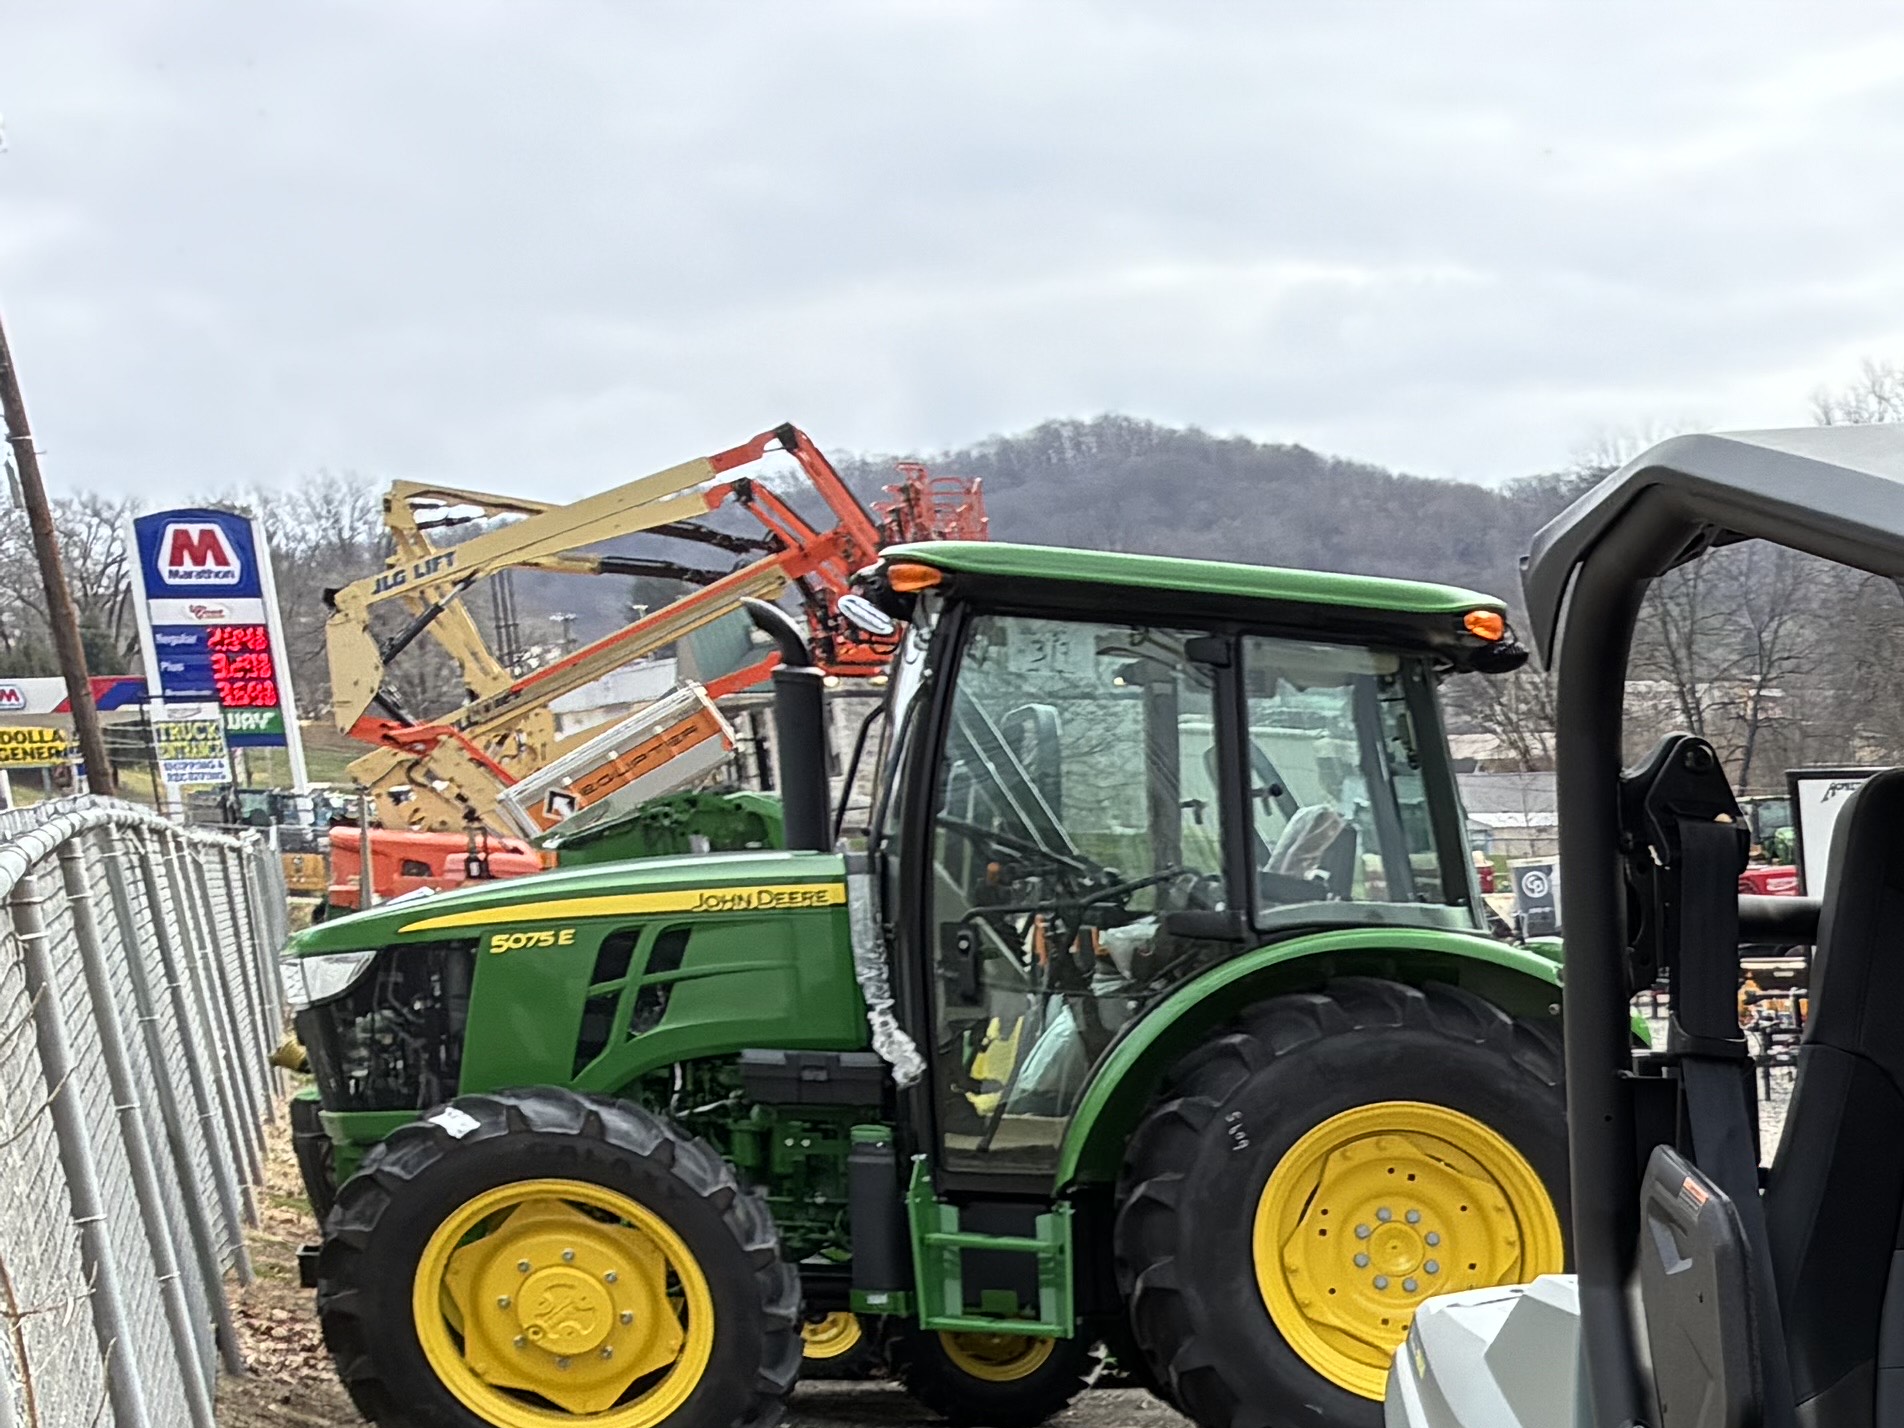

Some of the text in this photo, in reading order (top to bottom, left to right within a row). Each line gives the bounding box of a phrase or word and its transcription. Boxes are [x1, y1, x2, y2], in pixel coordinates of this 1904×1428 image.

[168, 569, 235, 580] Marathon
[372, 550, 457, 594] JLG LIFT
[1, 728, 66, 745] DOLLA
[158, 722, 220, 740] TRUCK
[0, 745, 58, 762] GENER
[692, 889, 830, 912] JOHN DEERE
[490, 929, 576, 954] 5075 E
